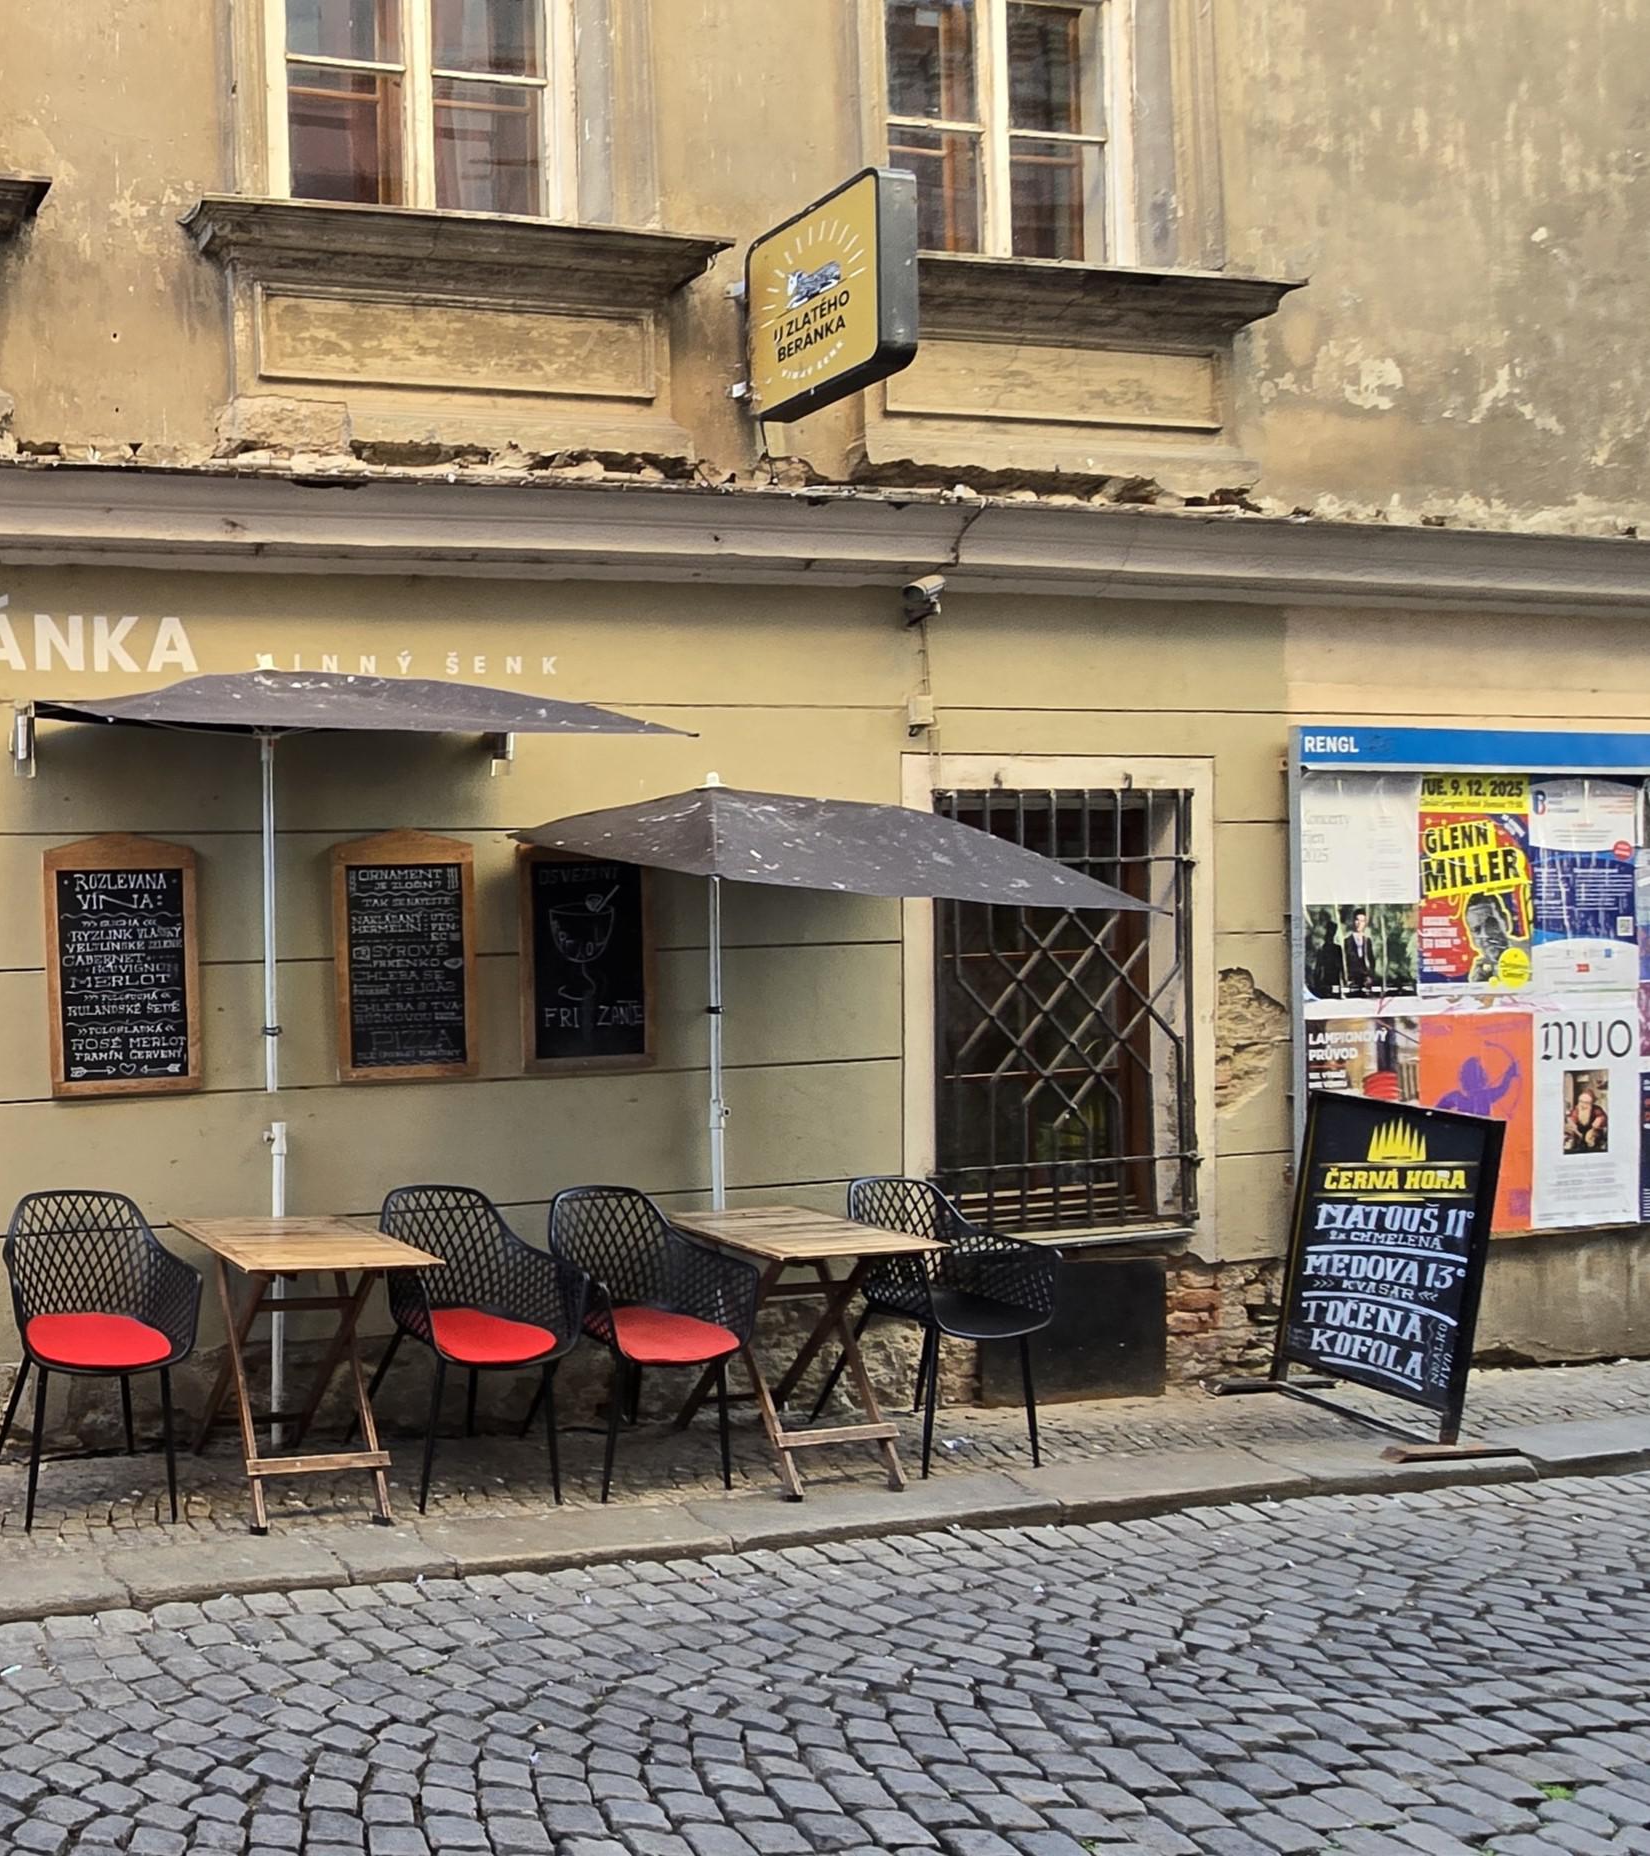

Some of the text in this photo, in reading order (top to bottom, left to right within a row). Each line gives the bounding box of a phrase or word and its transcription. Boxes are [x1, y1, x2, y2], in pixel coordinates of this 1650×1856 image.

[774, 290, 850, 343] U ZLATÉHO
[777, 314, 846, 363] BERÁNKA
[445, 652, 558, 675] ŠENK
[1304, 736, 1360, 753] RENGL
[1421, 778, 1524, 797] TUE. 9. 12. 2025
[1425, 823, 1489, 854] GLENN
[358, 869, 443, 882] ORNAMENT
[1422, 849, 1521, 893] MILLER
[62, 953, 146, 967] CABERNET
[70, 974, 171, 989] MERLOT
[351, 970, 419, 982] CHLEBA
[70, 1036, 186, 1050] ROSÉ MERLOT
[370, 1029, 453, 1051] PIZZA
[1308, 1027, 1388, 1045] LAMPIONOVÝ
[1309, 1045, 1358, 1061] PRŮVOD
[1324, 1167, 1466, 1190] ČERNÁ HORA
[1314, 1203, 1440, 1234] MATOUŠ
[1350, 1231, 1443, 1250] CHMELENÁ
[1425, 1263, 1467, 1290] 13°
[1342, 1279, 1415, 1300] KVASAR
[1310, 1328, 1425, 1381] KOFOLA
[1438, 1352, 1453, 1389] PIVO
